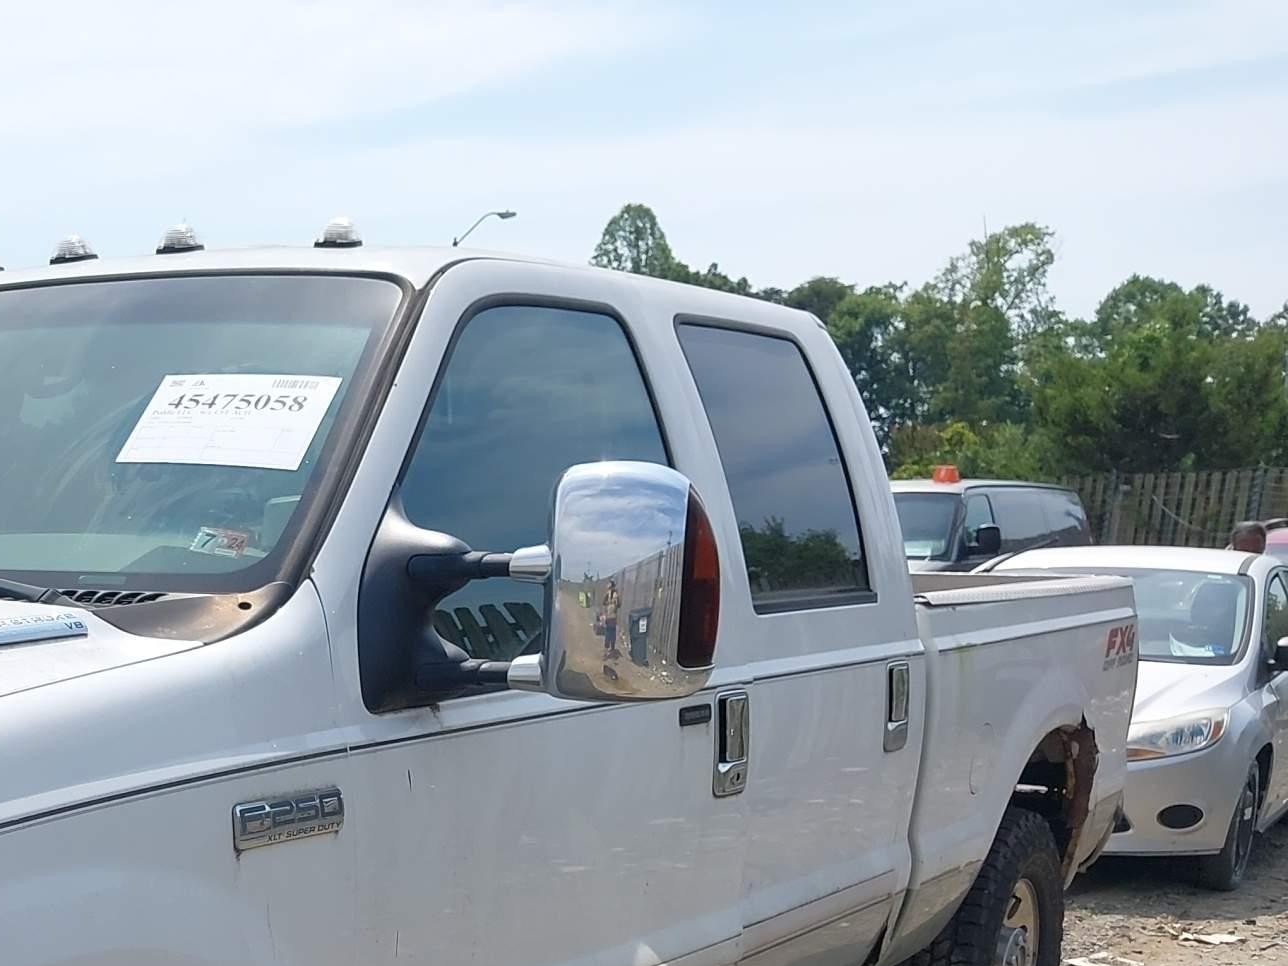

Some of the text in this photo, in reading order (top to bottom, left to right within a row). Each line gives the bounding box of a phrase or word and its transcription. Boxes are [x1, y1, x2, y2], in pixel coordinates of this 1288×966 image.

[168, 393, 307, 412] 45475058
[65, 621, 84, 631] V8
[1105, 624, 1135, 658] FX4
[267, 822, 341, 842] XLT SUPER DUTY
